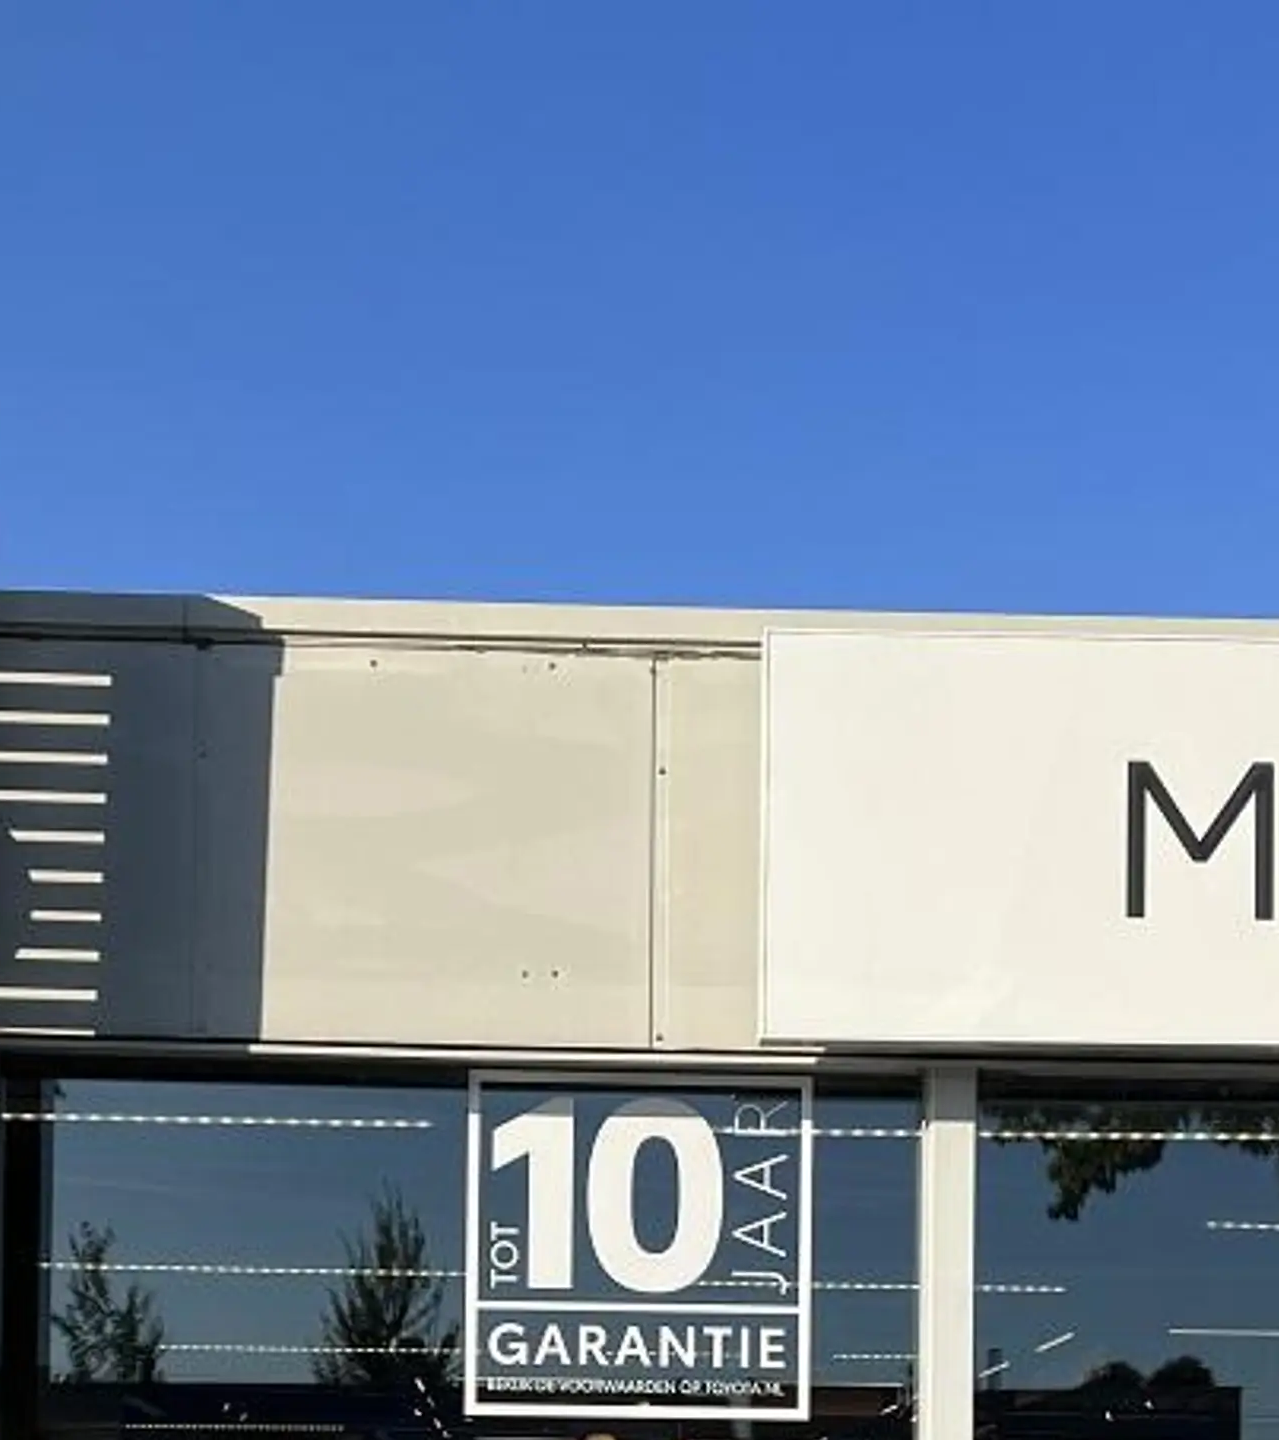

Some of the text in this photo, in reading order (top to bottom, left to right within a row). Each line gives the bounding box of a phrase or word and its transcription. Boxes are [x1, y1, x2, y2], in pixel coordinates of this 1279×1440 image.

[488, 1096, 790, 1296] TOT 10 JAAR
[487, 1322, 787, 1371] GARANTIE
